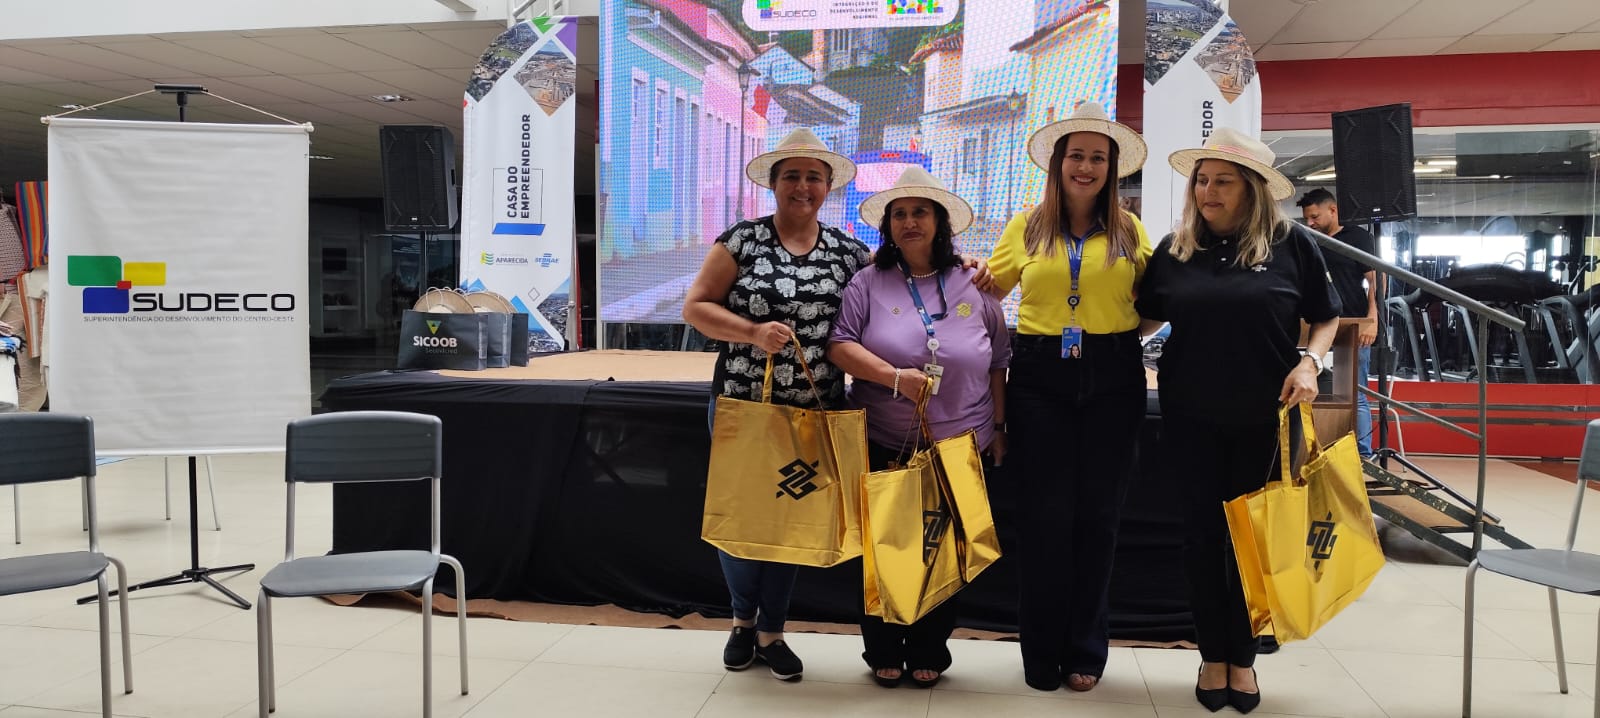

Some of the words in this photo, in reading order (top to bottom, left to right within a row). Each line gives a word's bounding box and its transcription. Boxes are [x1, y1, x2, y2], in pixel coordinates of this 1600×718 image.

[773, 9, 817, 18] SUDECO
[1202, 100, 1213, 148] EDOR
[507, 166, 518, 184] DO
[520, 114, 531, 219] EMPREENDEDOR
[507, 185, 518, 218] CASA
[132, 292, 295, 312] SUDECO
[83, 315, 153, 323] SUPERINTENDÊNCIA
[413, 335, 458, 348] SICOOB
